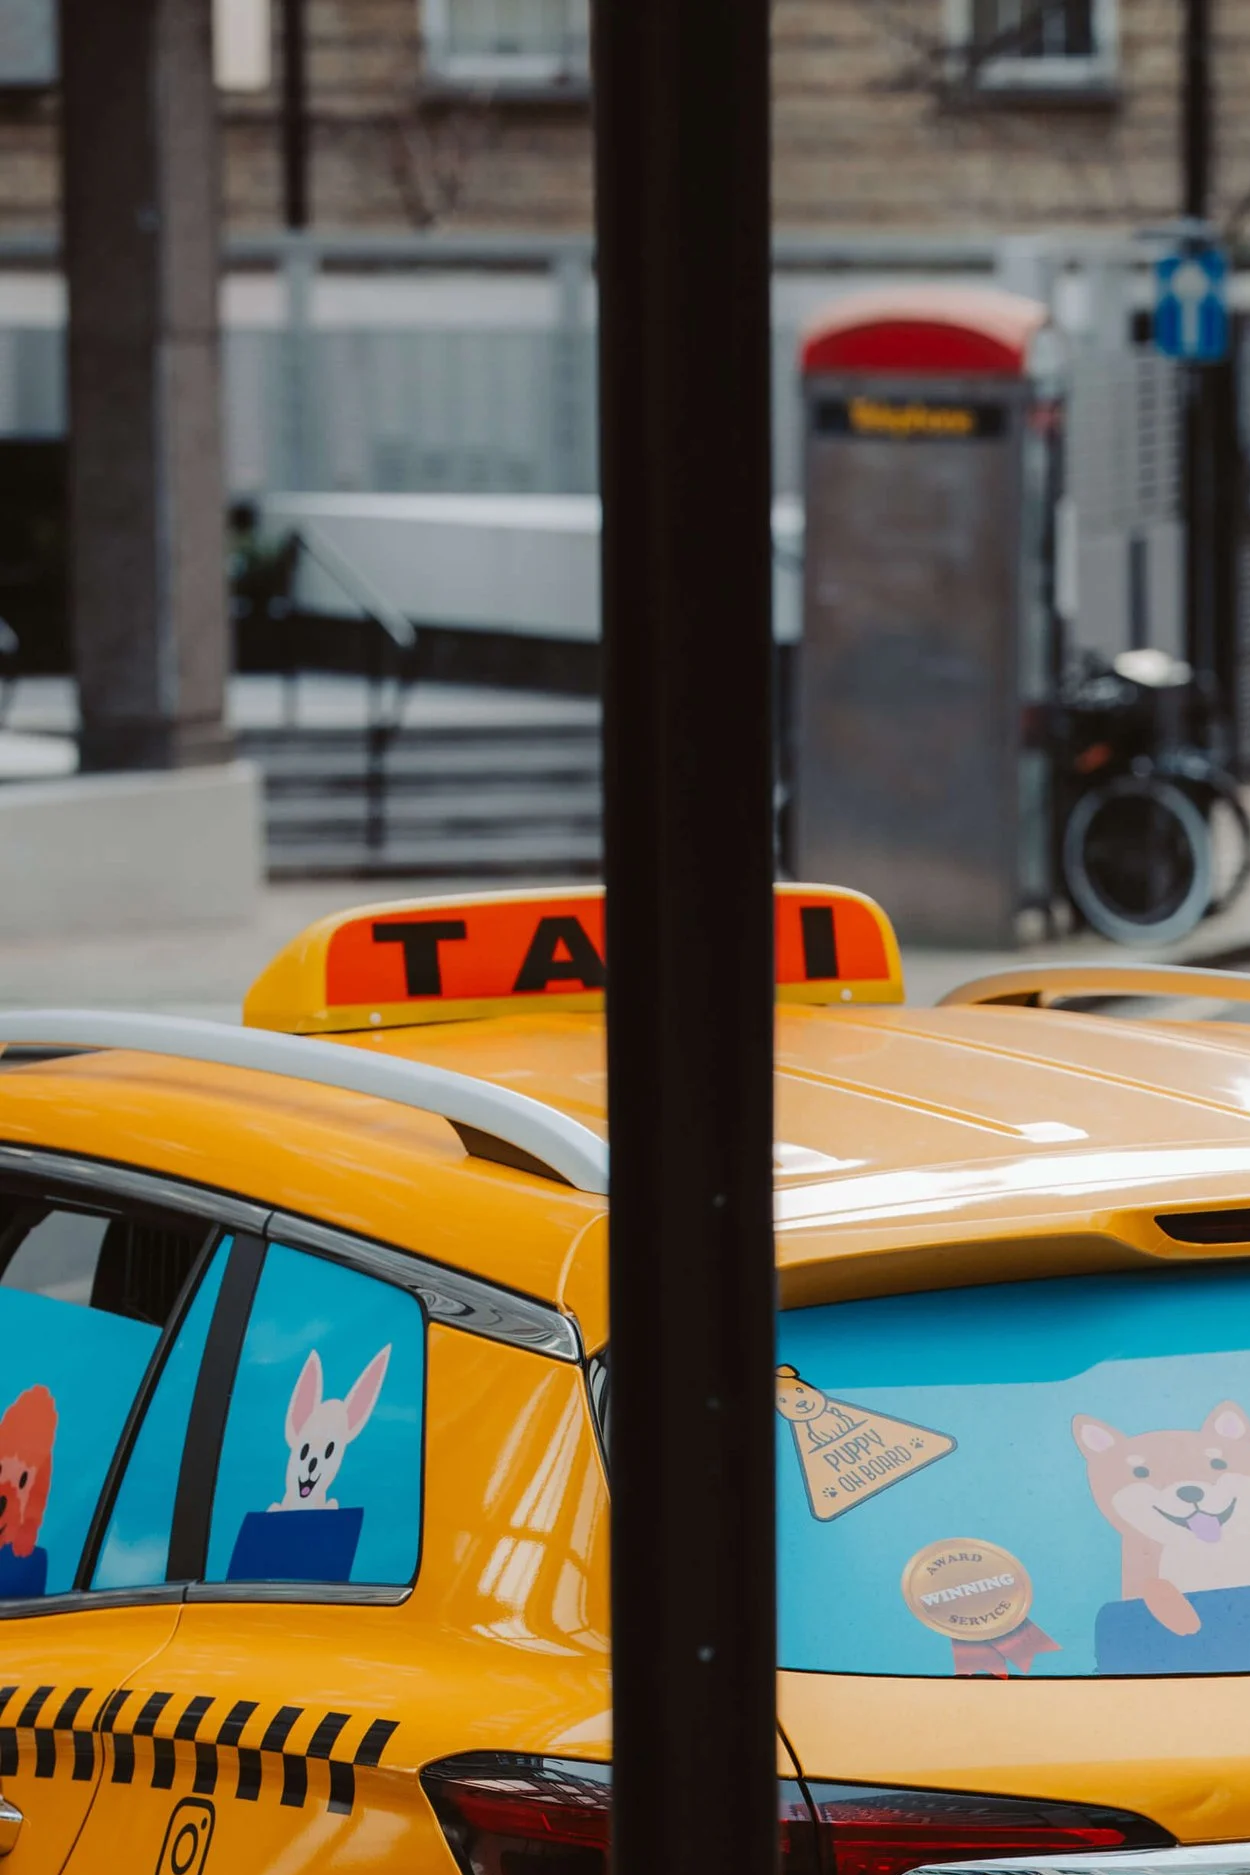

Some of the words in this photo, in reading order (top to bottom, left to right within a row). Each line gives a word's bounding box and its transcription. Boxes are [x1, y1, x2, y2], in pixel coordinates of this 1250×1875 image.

[371, 905, 839, 997] TAI
[822, 1429, 886, 1472] PUPPY
[864, 1445, 912, 1482] BOARD
[926, 1552, 982, 1576] AWARD
[919, 1573, 1015, 1606] WINNING
[949, 1600, 1011, 1626] SERVICE
